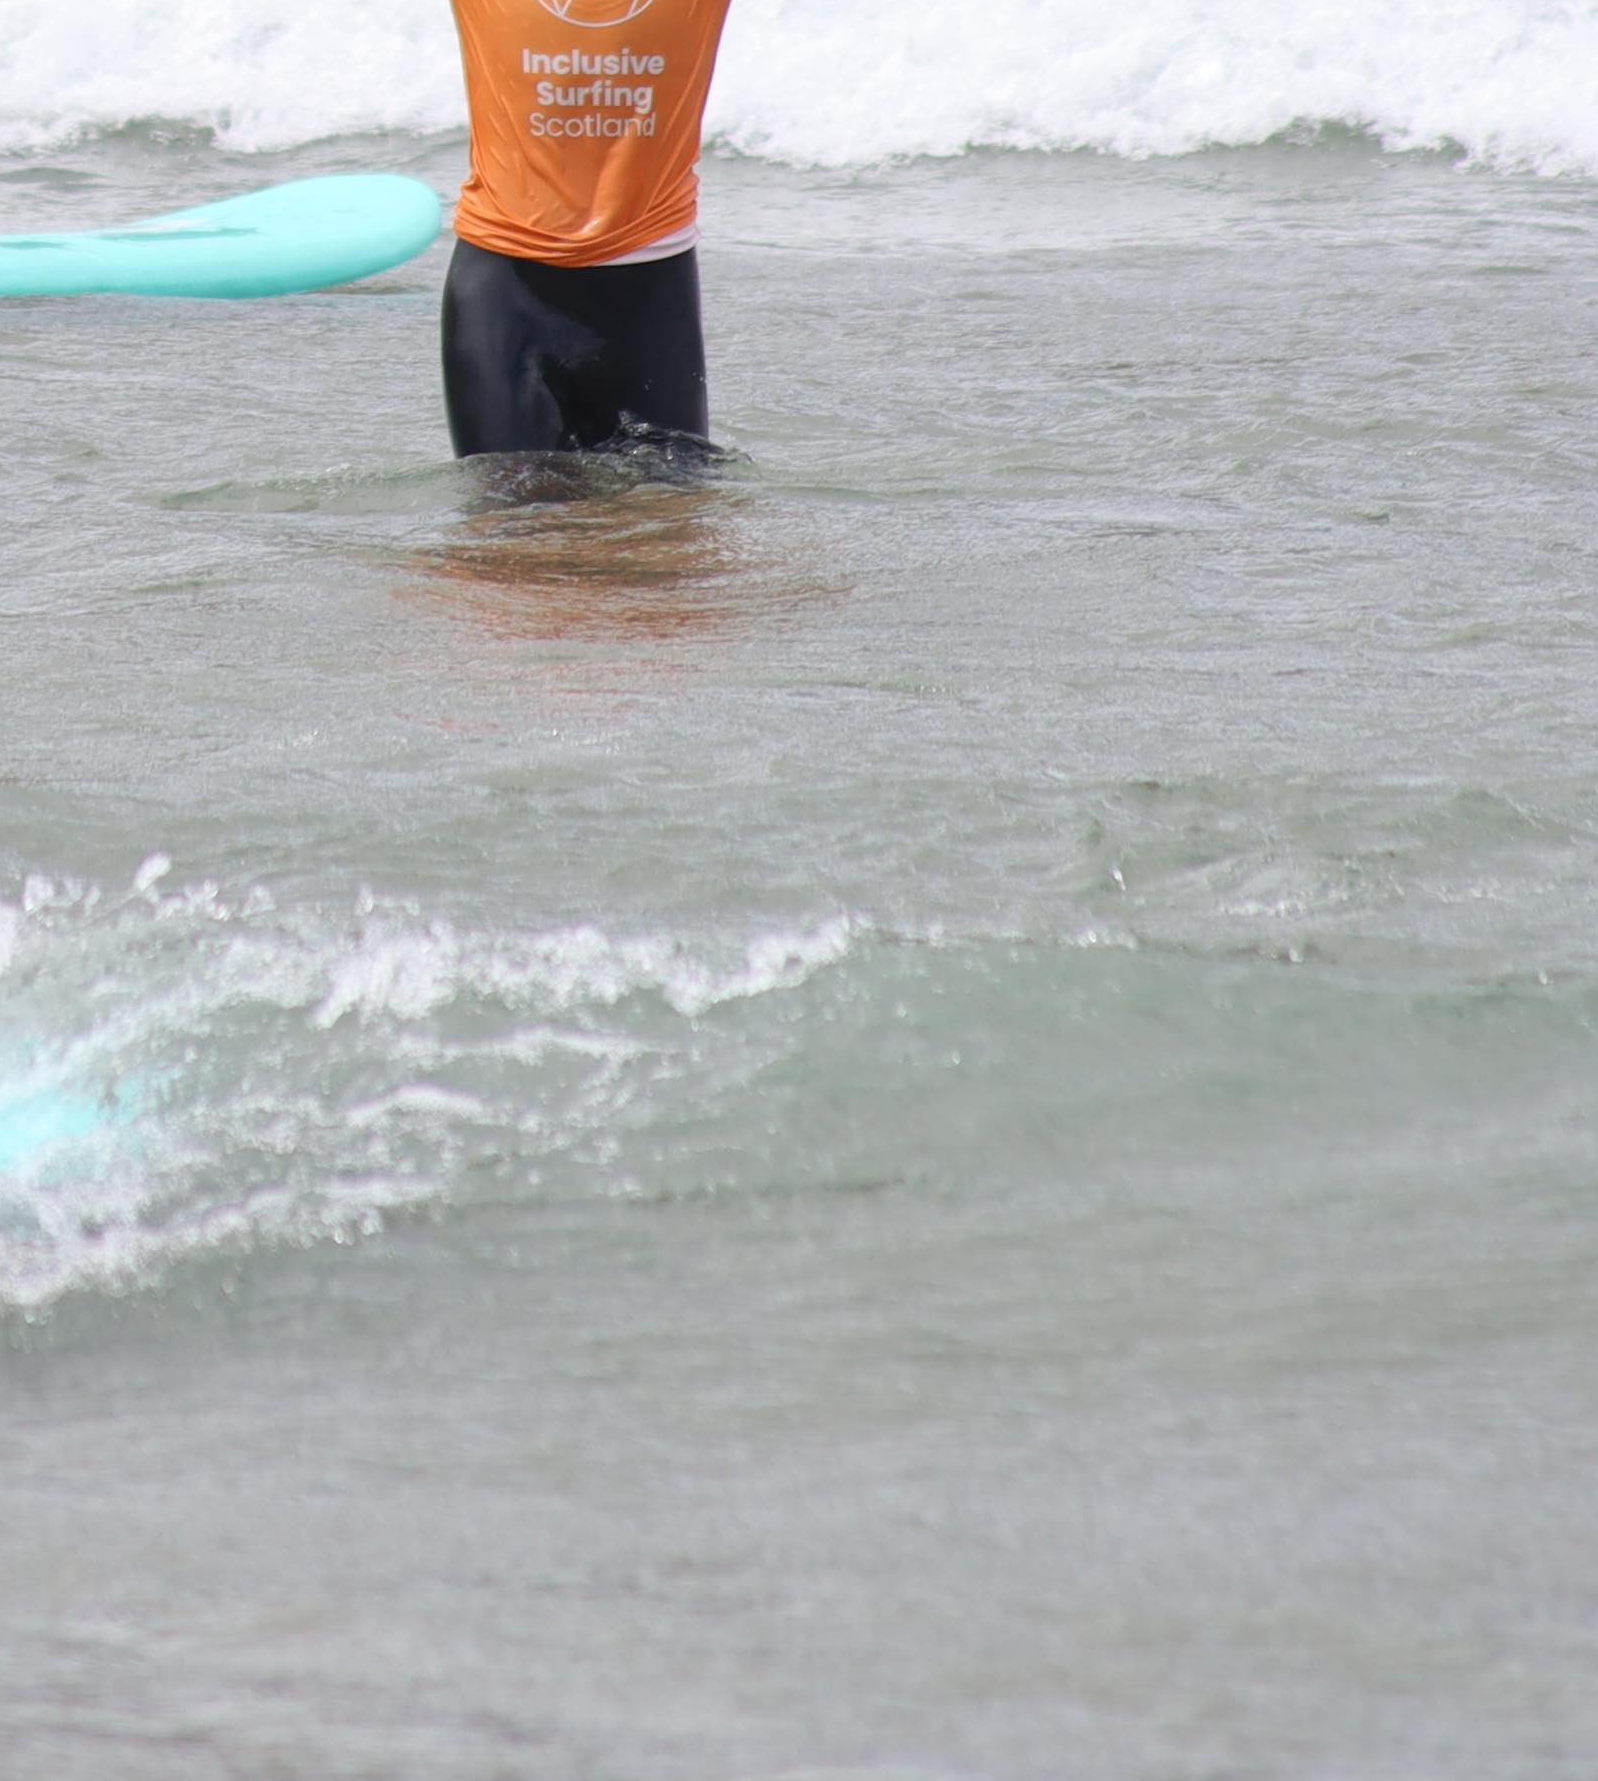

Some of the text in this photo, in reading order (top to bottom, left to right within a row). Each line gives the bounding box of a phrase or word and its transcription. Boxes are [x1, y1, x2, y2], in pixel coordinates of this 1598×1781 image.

[522, 48, 665, 75] Inclusive
[536, 80, 653, 114] Surfing
[529, 112, 656, 137] Scotland
